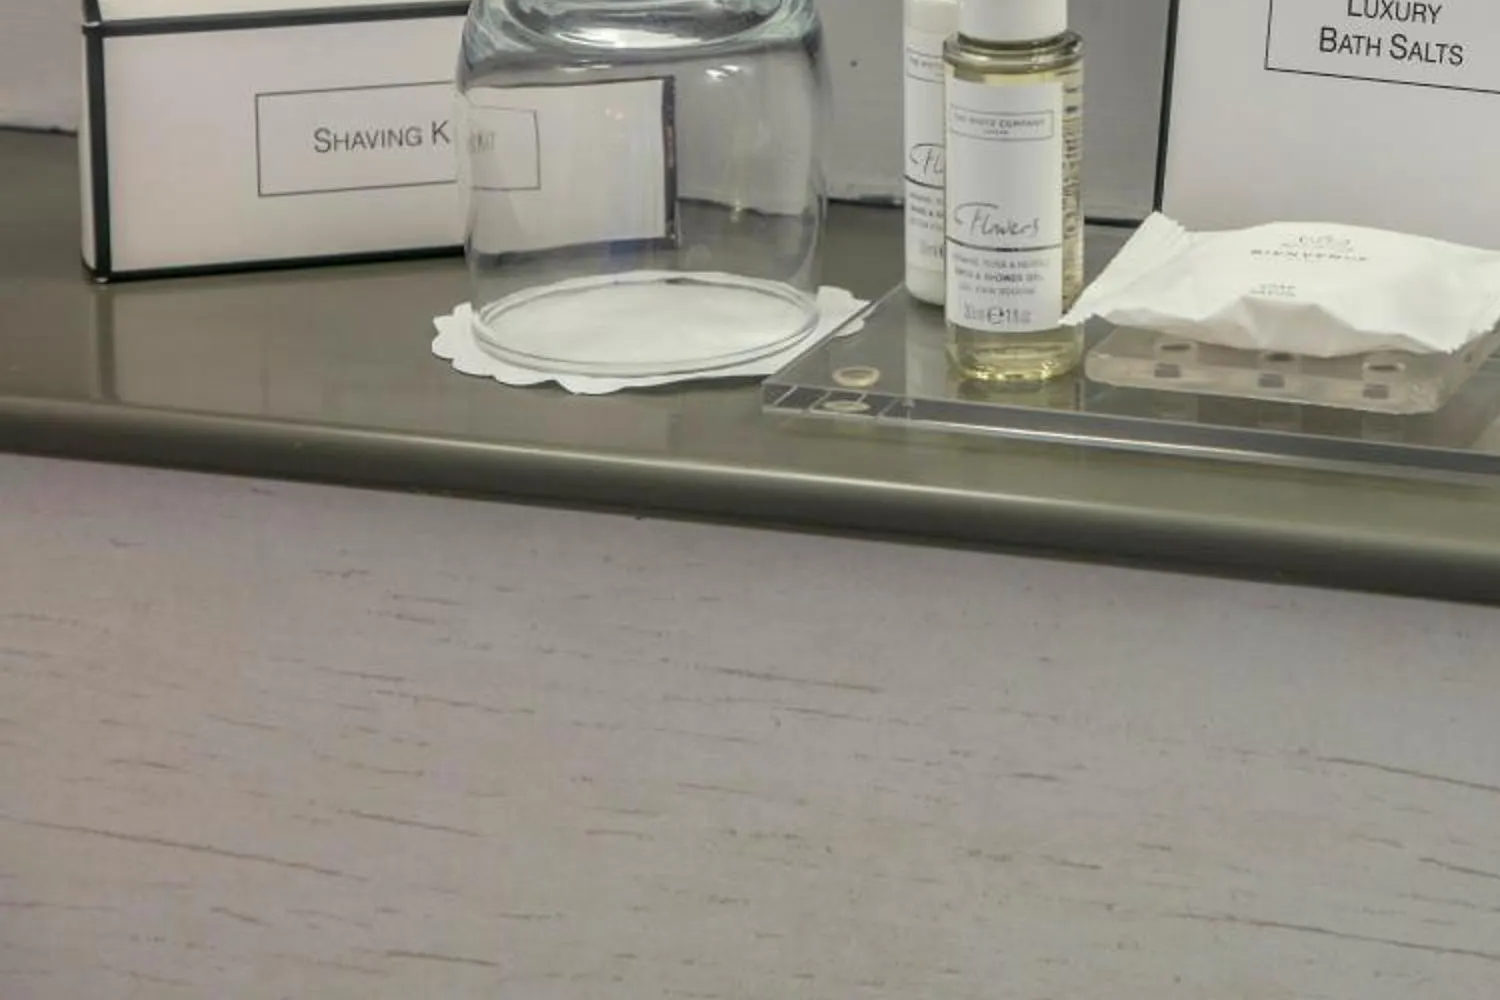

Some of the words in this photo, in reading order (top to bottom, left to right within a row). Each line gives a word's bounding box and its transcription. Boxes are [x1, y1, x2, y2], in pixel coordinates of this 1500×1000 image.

[1319, 26, 1381, 57] BATH
[1389, 33, 1464, 66] SALTS
[313, 127, 423, 153] SHAVING
[954, 202, 1040, 237] Flowers
